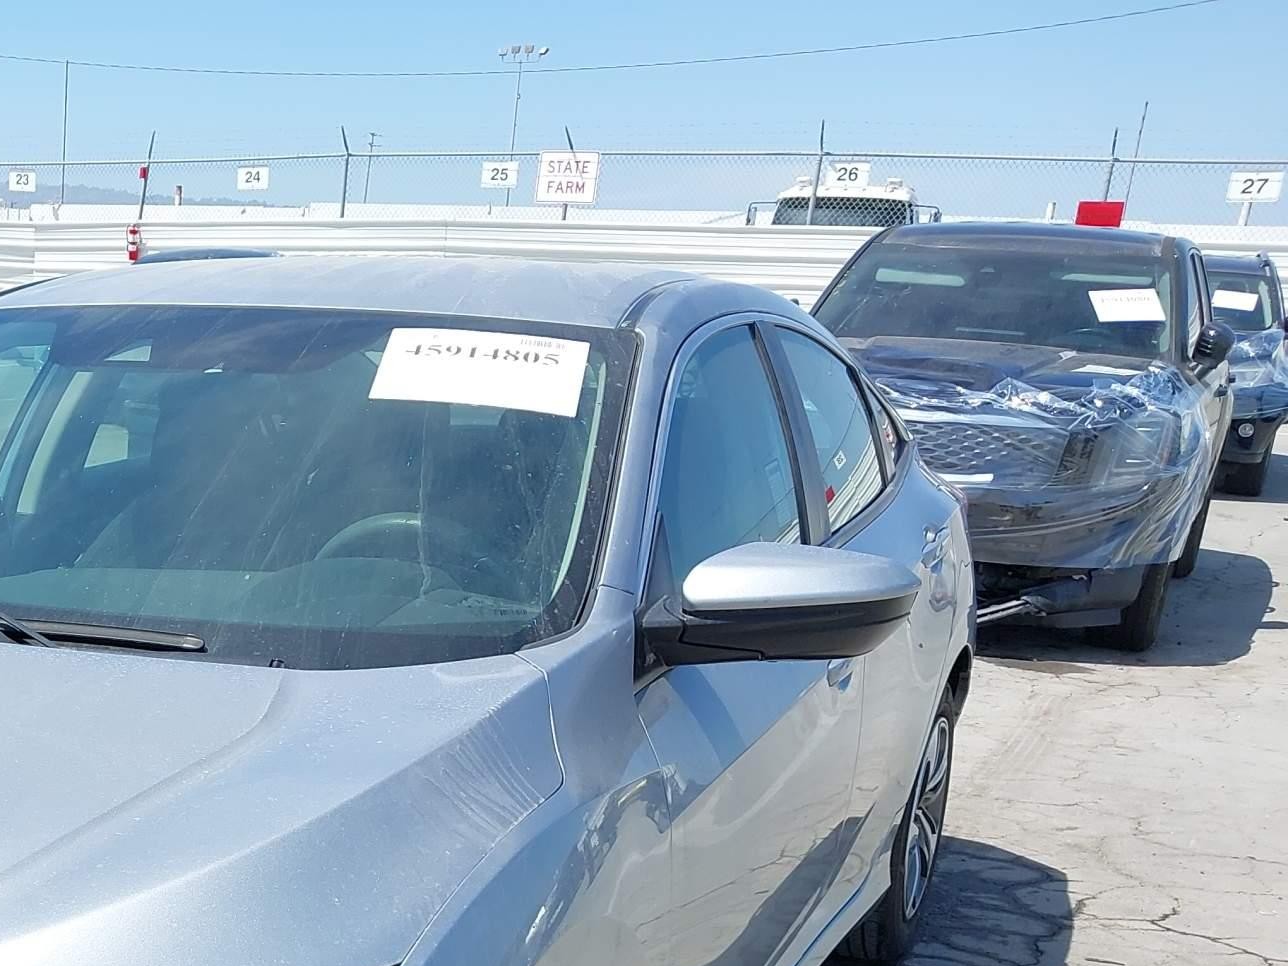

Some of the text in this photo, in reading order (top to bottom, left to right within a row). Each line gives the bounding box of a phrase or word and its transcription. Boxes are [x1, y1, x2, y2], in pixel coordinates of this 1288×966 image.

[547, 160, 591, 174] STATE
[16, 173, 29, 185] 23
[245, 170, 260, 183] 24
[490, 168, 509, 181] 25
[837, 167, 859, 182] 26
[546, 180, 585, 194] FARM
[1241, 178, 1270, 194] 27
[405, 344, 560, 366] 45914805
